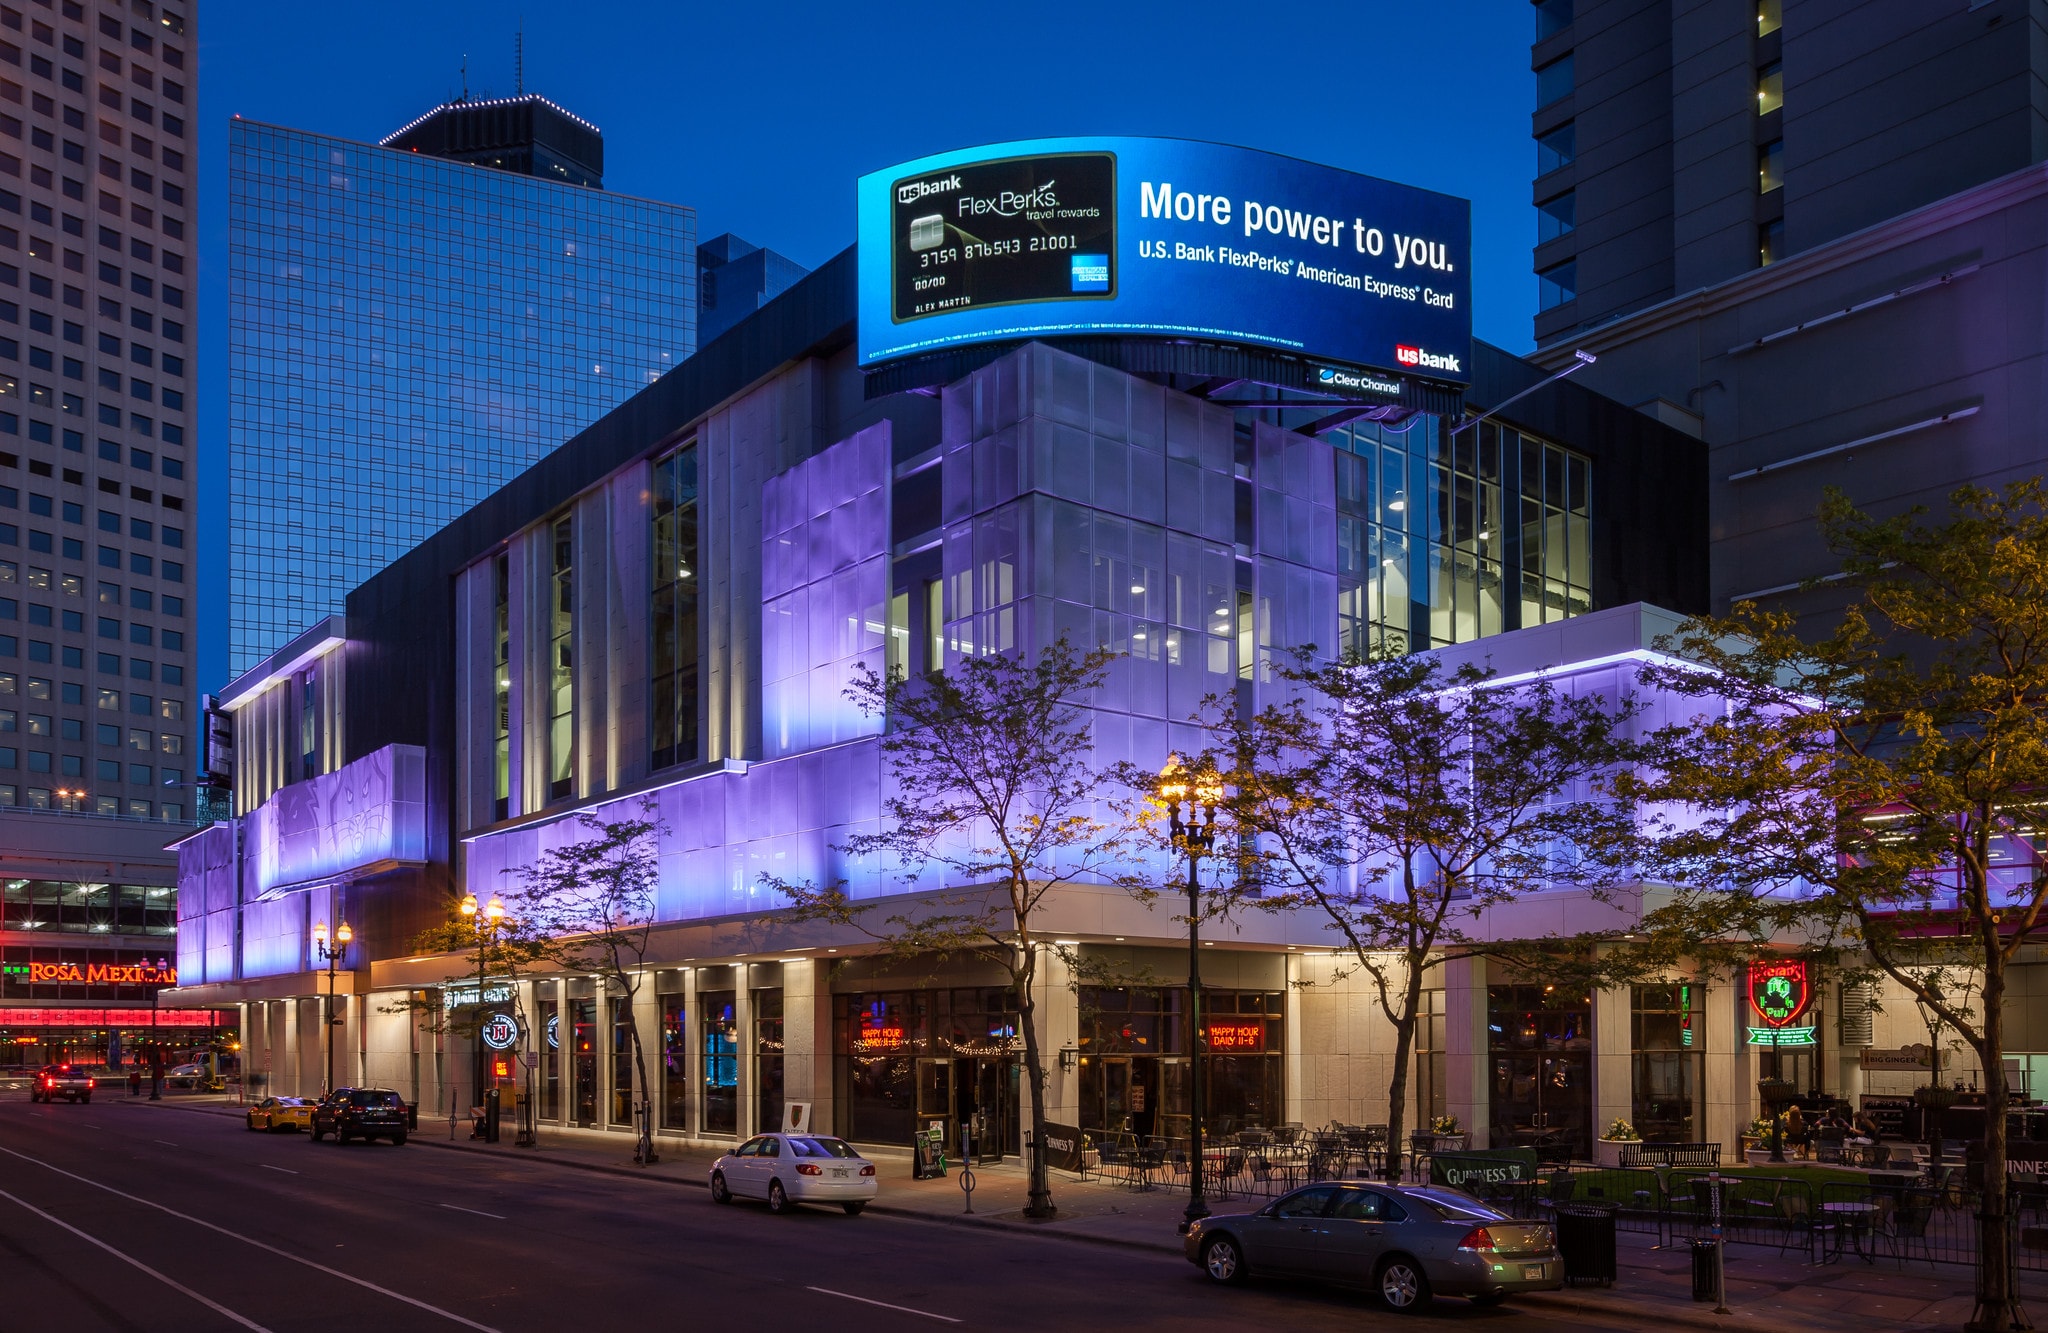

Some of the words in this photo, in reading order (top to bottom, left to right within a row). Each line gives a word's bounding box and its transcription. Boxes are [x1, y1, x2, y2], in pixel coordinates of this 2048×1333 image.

[1026, 209, 1055, 220] travel
[1057, 207, 1100, 218] rewards
[1140, 181, 1231, 225] More
[1244, 200, 1344, 247] power
[1353, 217, 1383, 256] to
[1393, 233, 1453, 272] you.
[921, 248, 957, 268] 3759
[964, 240, 1020, 259] 876543
[1030, 235, 1077, 252] 21001
[1139, 240, 1171, 258] U.S.
[1175, 244, 1215, 263] Bank
[1296, 261, 1361, 290] American
[1424, 288, 1453, 308] Card
[915, 302, 936, 313] ALEX
[938, 296, 971, 309] MARTIN
[1334, 373, 1361, 387] Clear
[1361, 377, 1400, 394] Channel
[30, 962, 83, 982] ROSA
[1766, 1007, 1788, 1018] Pub
[862, 1029, 881, 1038] HAPPY
[882, 1028, 901, 1037] HOUR
[1211, 1027, 1235, 1036] HAPPY
[1237, 1027, 1259, 1036] HOUR
[1213, 1036, 1236, 1046] DAILY
